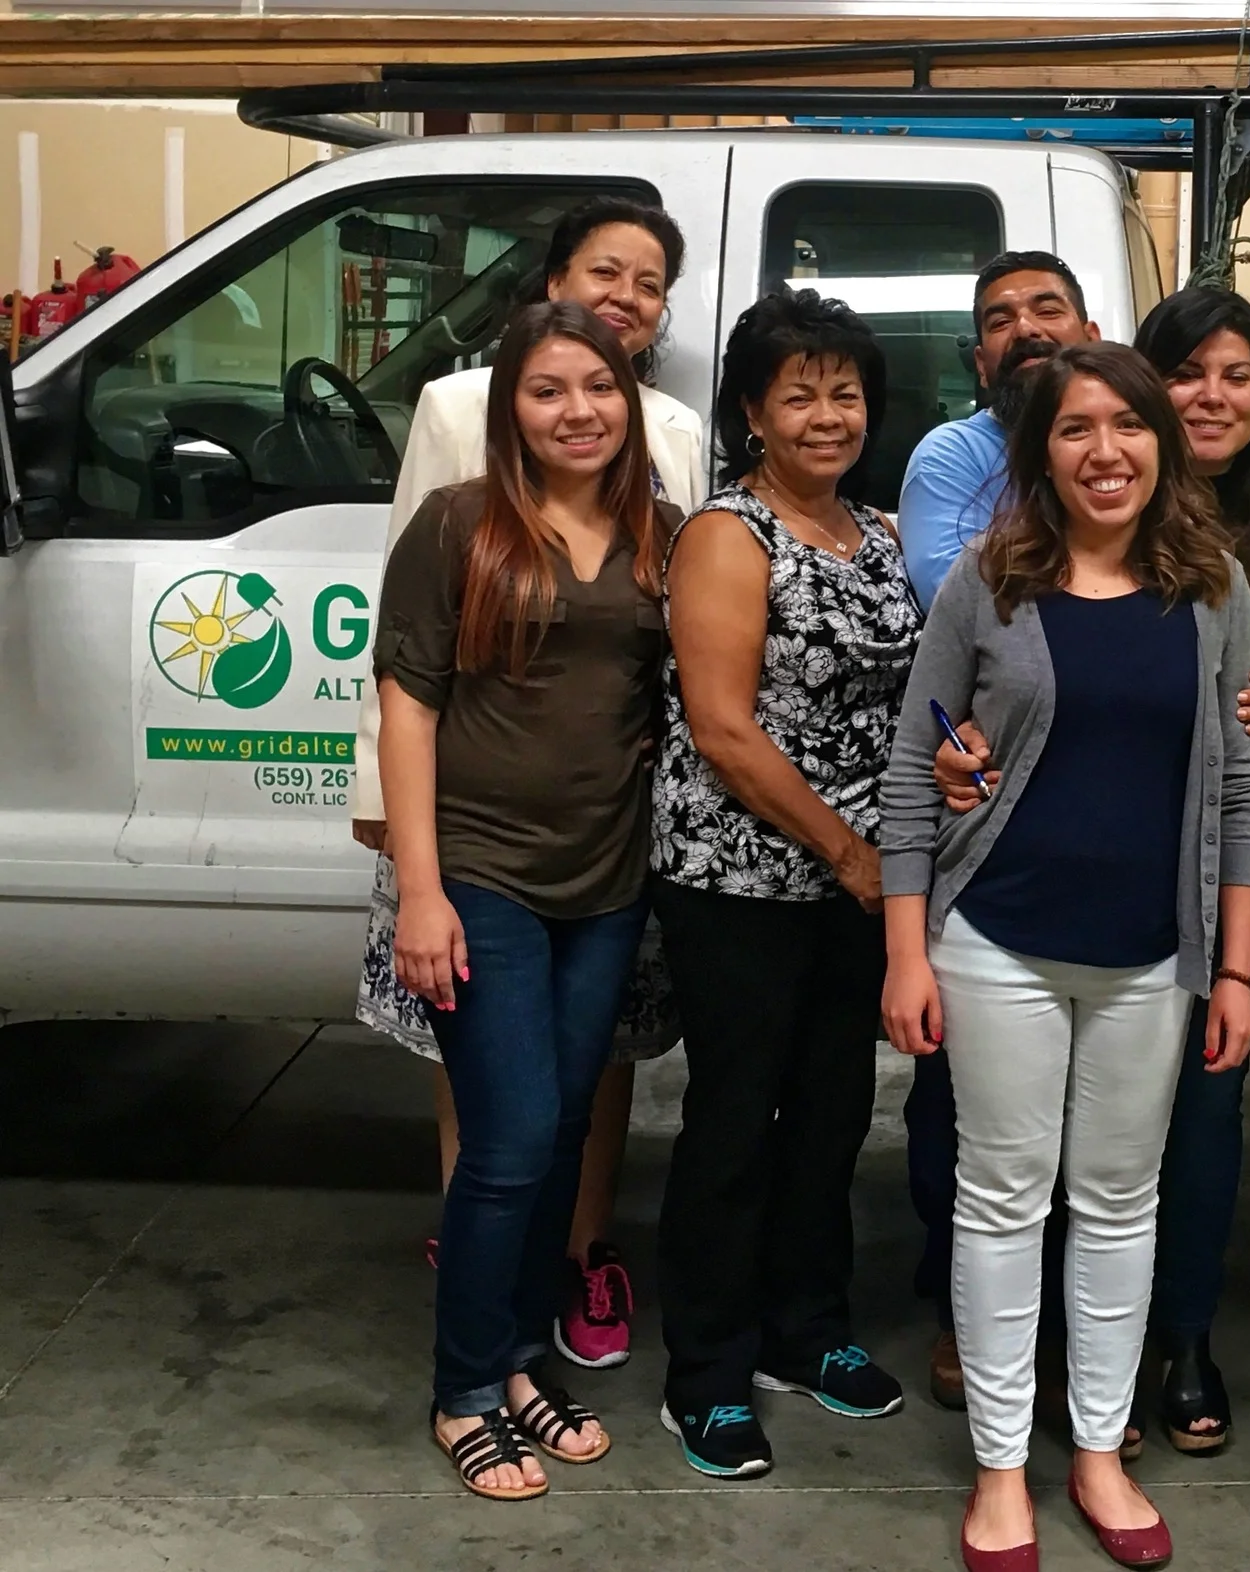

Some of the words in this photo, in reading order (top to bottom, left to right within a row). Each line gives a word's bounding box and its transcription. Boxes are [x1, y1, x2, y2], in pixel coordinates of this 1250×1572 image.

[312, 583, 370, 661] G
[314, 678, 365, 701] ALT
[161, 735, 357, 759] www.gridalte
[254, 766, 313, 791] (559)
[271, 791, 318, 806] CONT.
[323, 793, 348, 807] LIC
